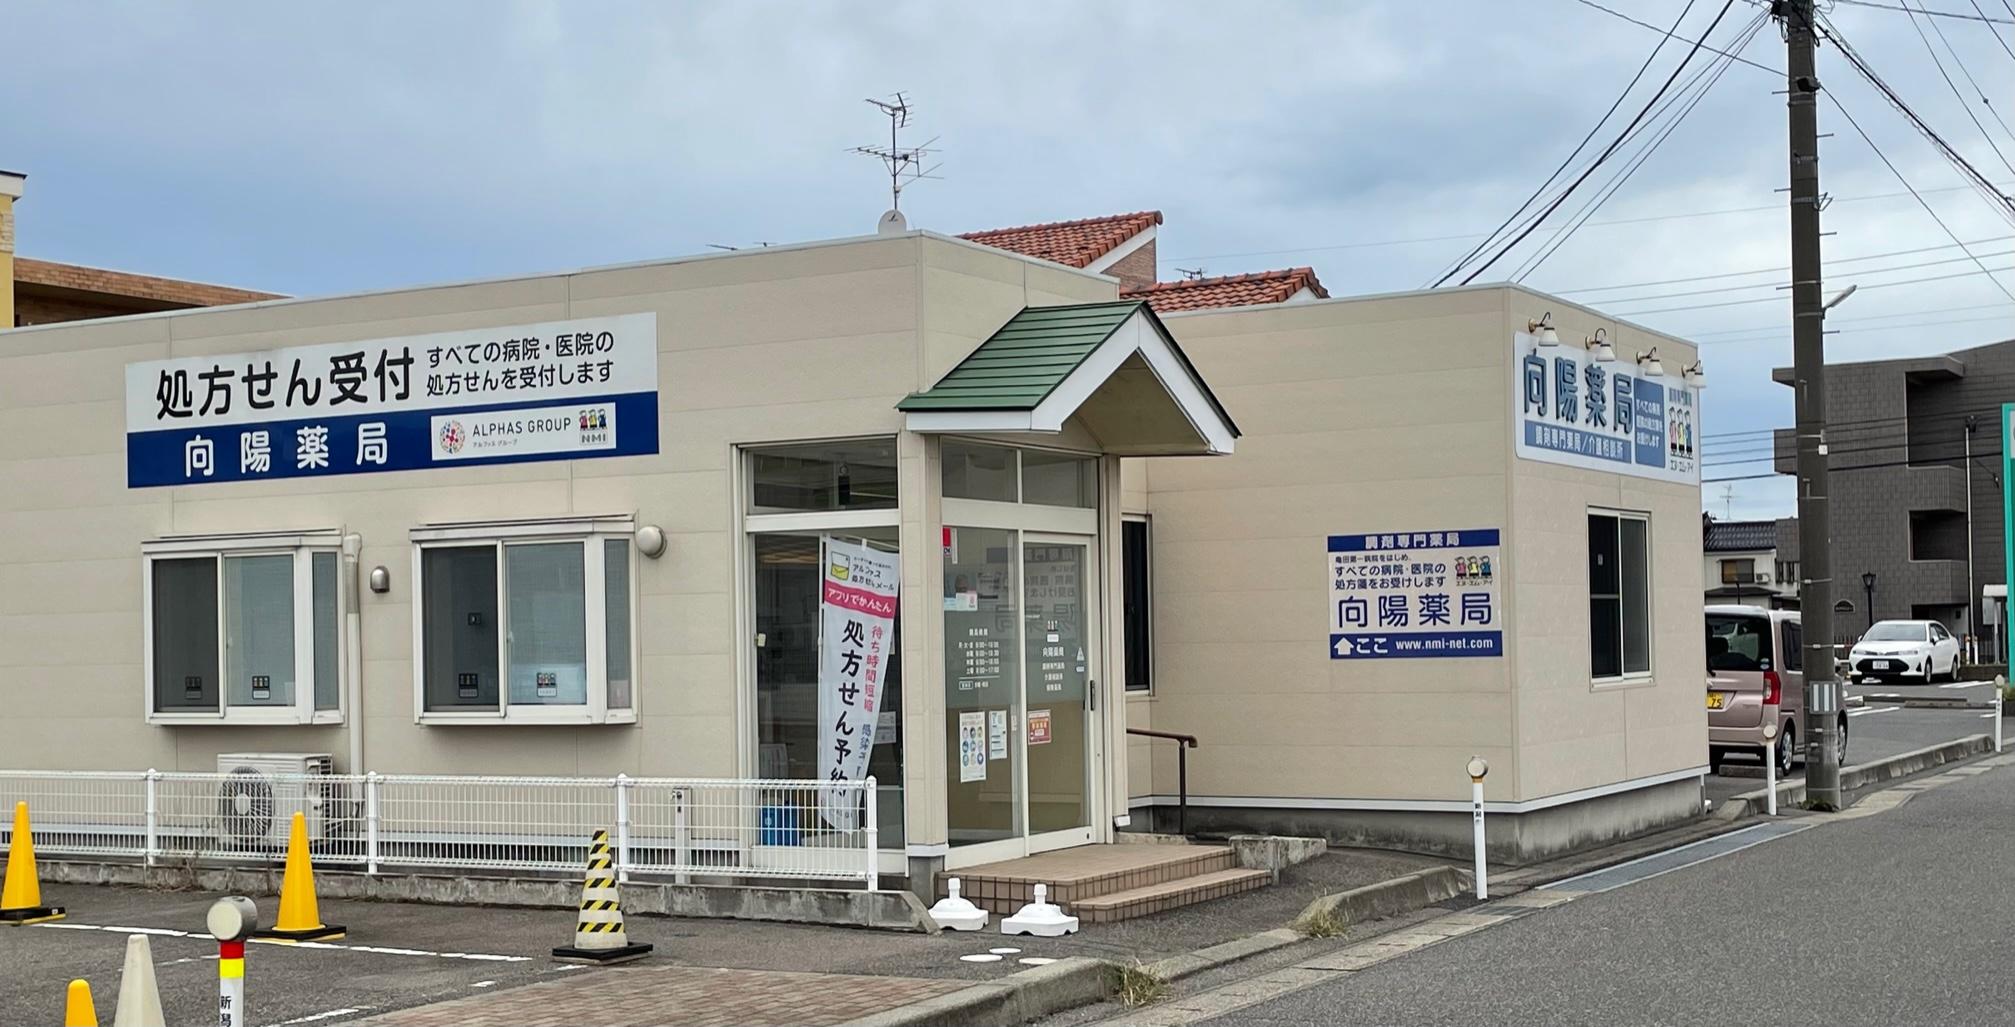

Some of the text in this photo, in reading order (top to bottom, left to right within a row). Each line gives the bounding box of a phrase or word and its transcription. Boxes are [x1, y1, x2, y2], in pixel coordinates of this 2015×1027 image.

[426, 331, 614, 368] すべての病院・医院の
[156, 347, 414, 420] 処方せん受付
[426, 359, 614, 397] 処方せんを受付します
[1523, 348, 1633, 434] 向陽薬局
[472, 417, 571, 437] ALPHAS GROUP
[581, 433, 607, 444] NMI
[185, 422, 388, 477] 向陽薬局
[1365, 532, 1460, 550] 調剤専門薬局
[1335, 563, 1447, 577] すべての病院・医院の
[1338, 592, 1492, 628] 向陽薬局
[1356, 637, 1493, 653] ここ www.nmi-net.com
